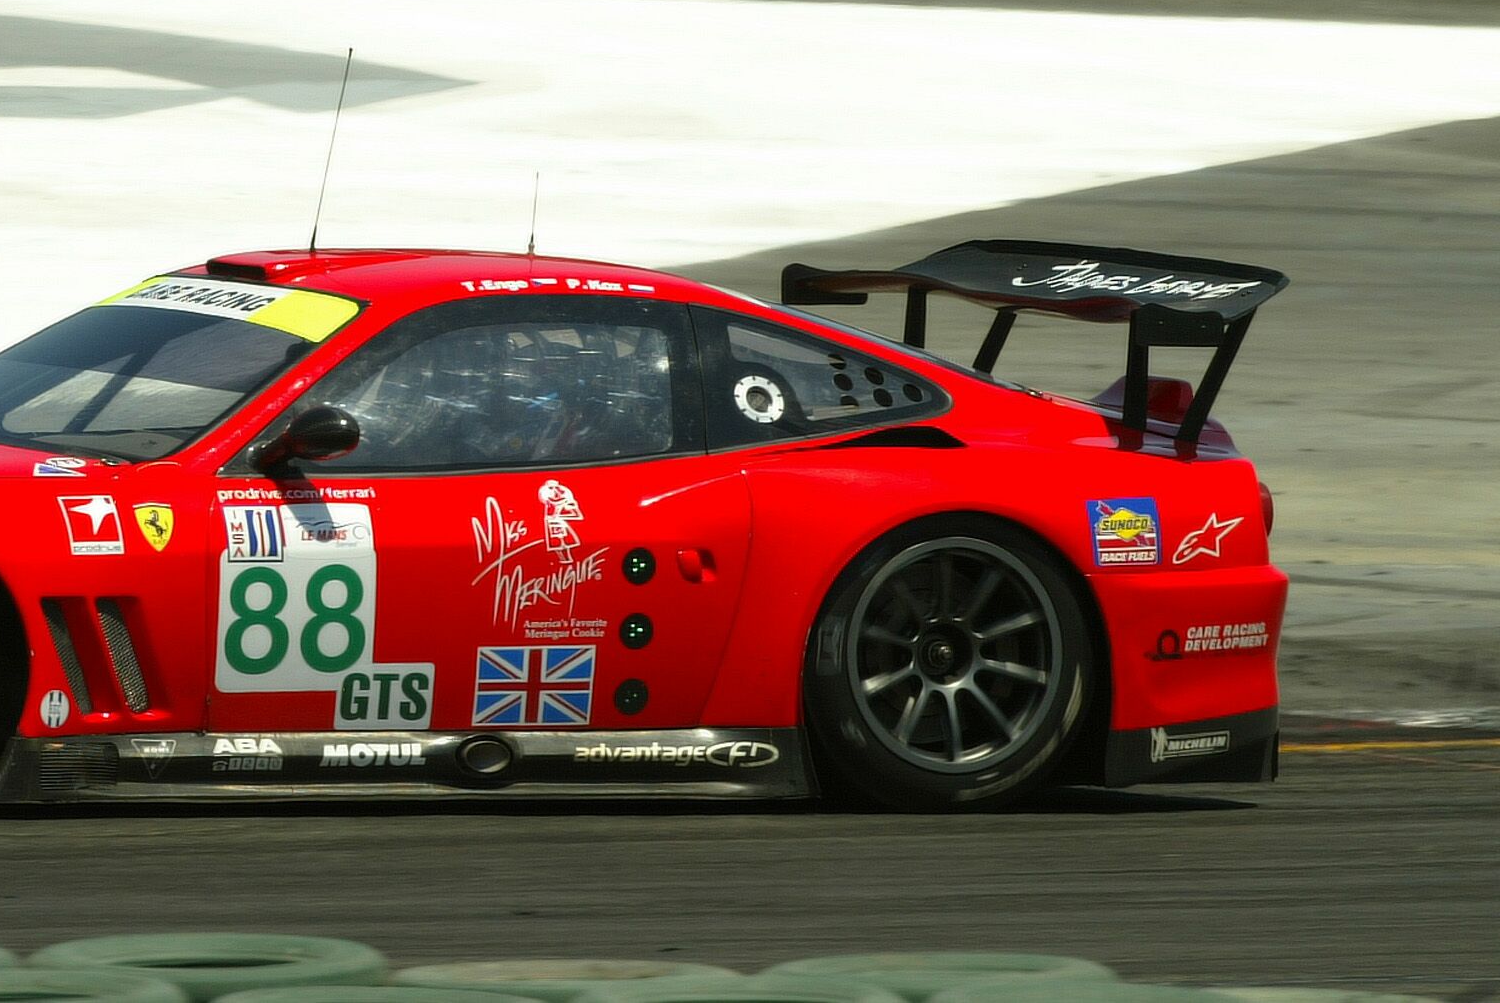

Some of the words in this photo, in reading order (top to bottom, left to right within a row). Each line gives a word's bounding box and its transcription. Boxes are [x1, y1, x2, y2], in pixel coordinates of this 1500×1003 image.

[176, 288, 276, 311] RACING
[1102, 518, 1149, 531] SUNOCO
[1101, 551, 1126, 562] RACE
[1128, 550, 1156, 561] FUELS
[224, 563, 366, 675] 88
[1187, 625, 1220, 639] CARE
[1223, 622, 1266, 637] RACING
[1184, 634, 1269, 652] DEVELOPMENT
[340, 672, 429, 721] GTS
[213, 738, 283, 754] ABA
[1168, 736, 1227, 750] MICHELIN
[320, 742, 426, 767] MOTUL
[574, 742, 707, 766] advantage
